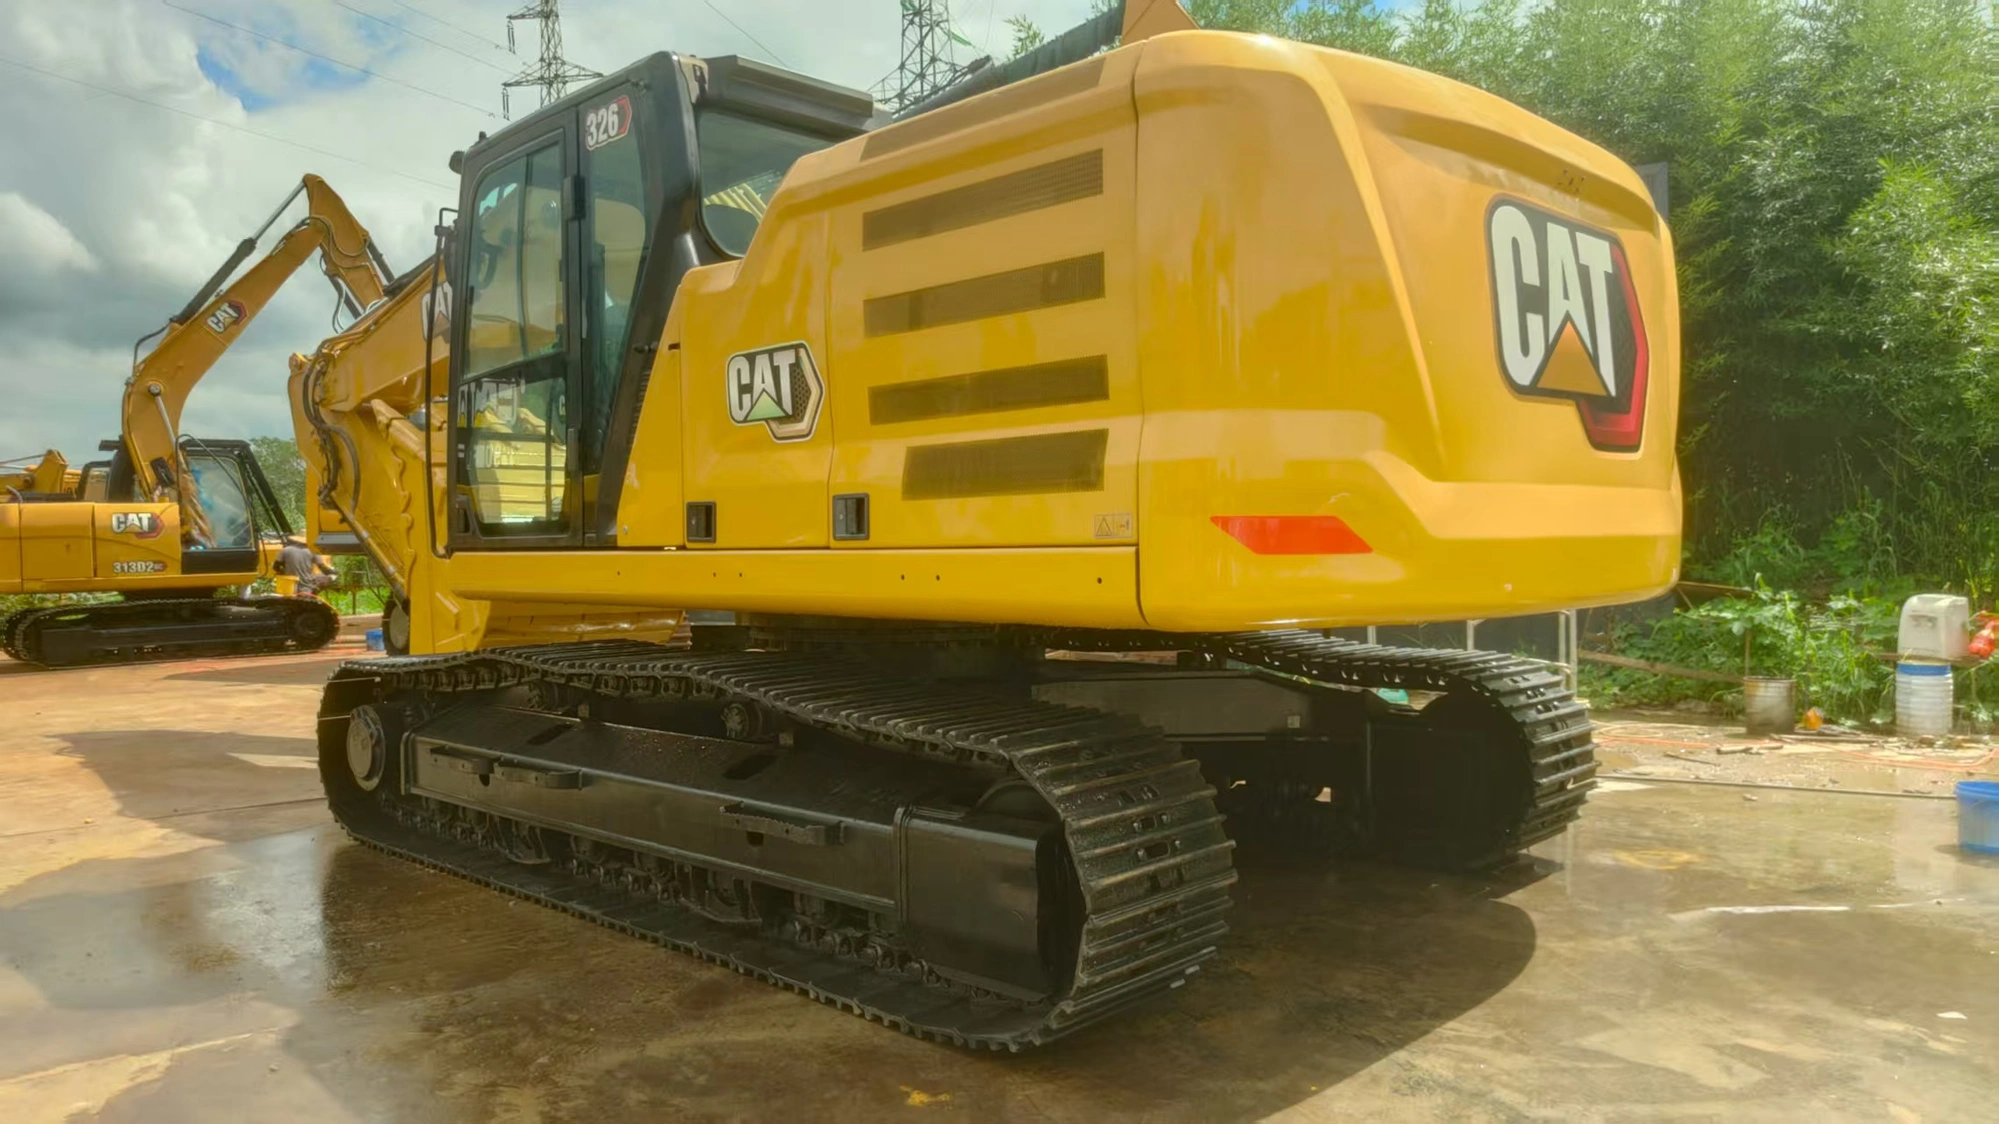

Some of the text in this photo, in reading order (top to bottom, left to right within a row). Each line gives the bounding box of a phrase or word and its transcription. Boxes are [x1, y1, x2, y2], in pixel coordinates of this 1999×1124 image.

[586, 103, 619, 146] 326
[206, 301, 240, 333] CAT
[1490, 204, 1617, 398] CAT
[728, 348, 796, 422] CAT
[112, 512, 152, 533] CAT
[112, 561, 154, 573] 313D2
